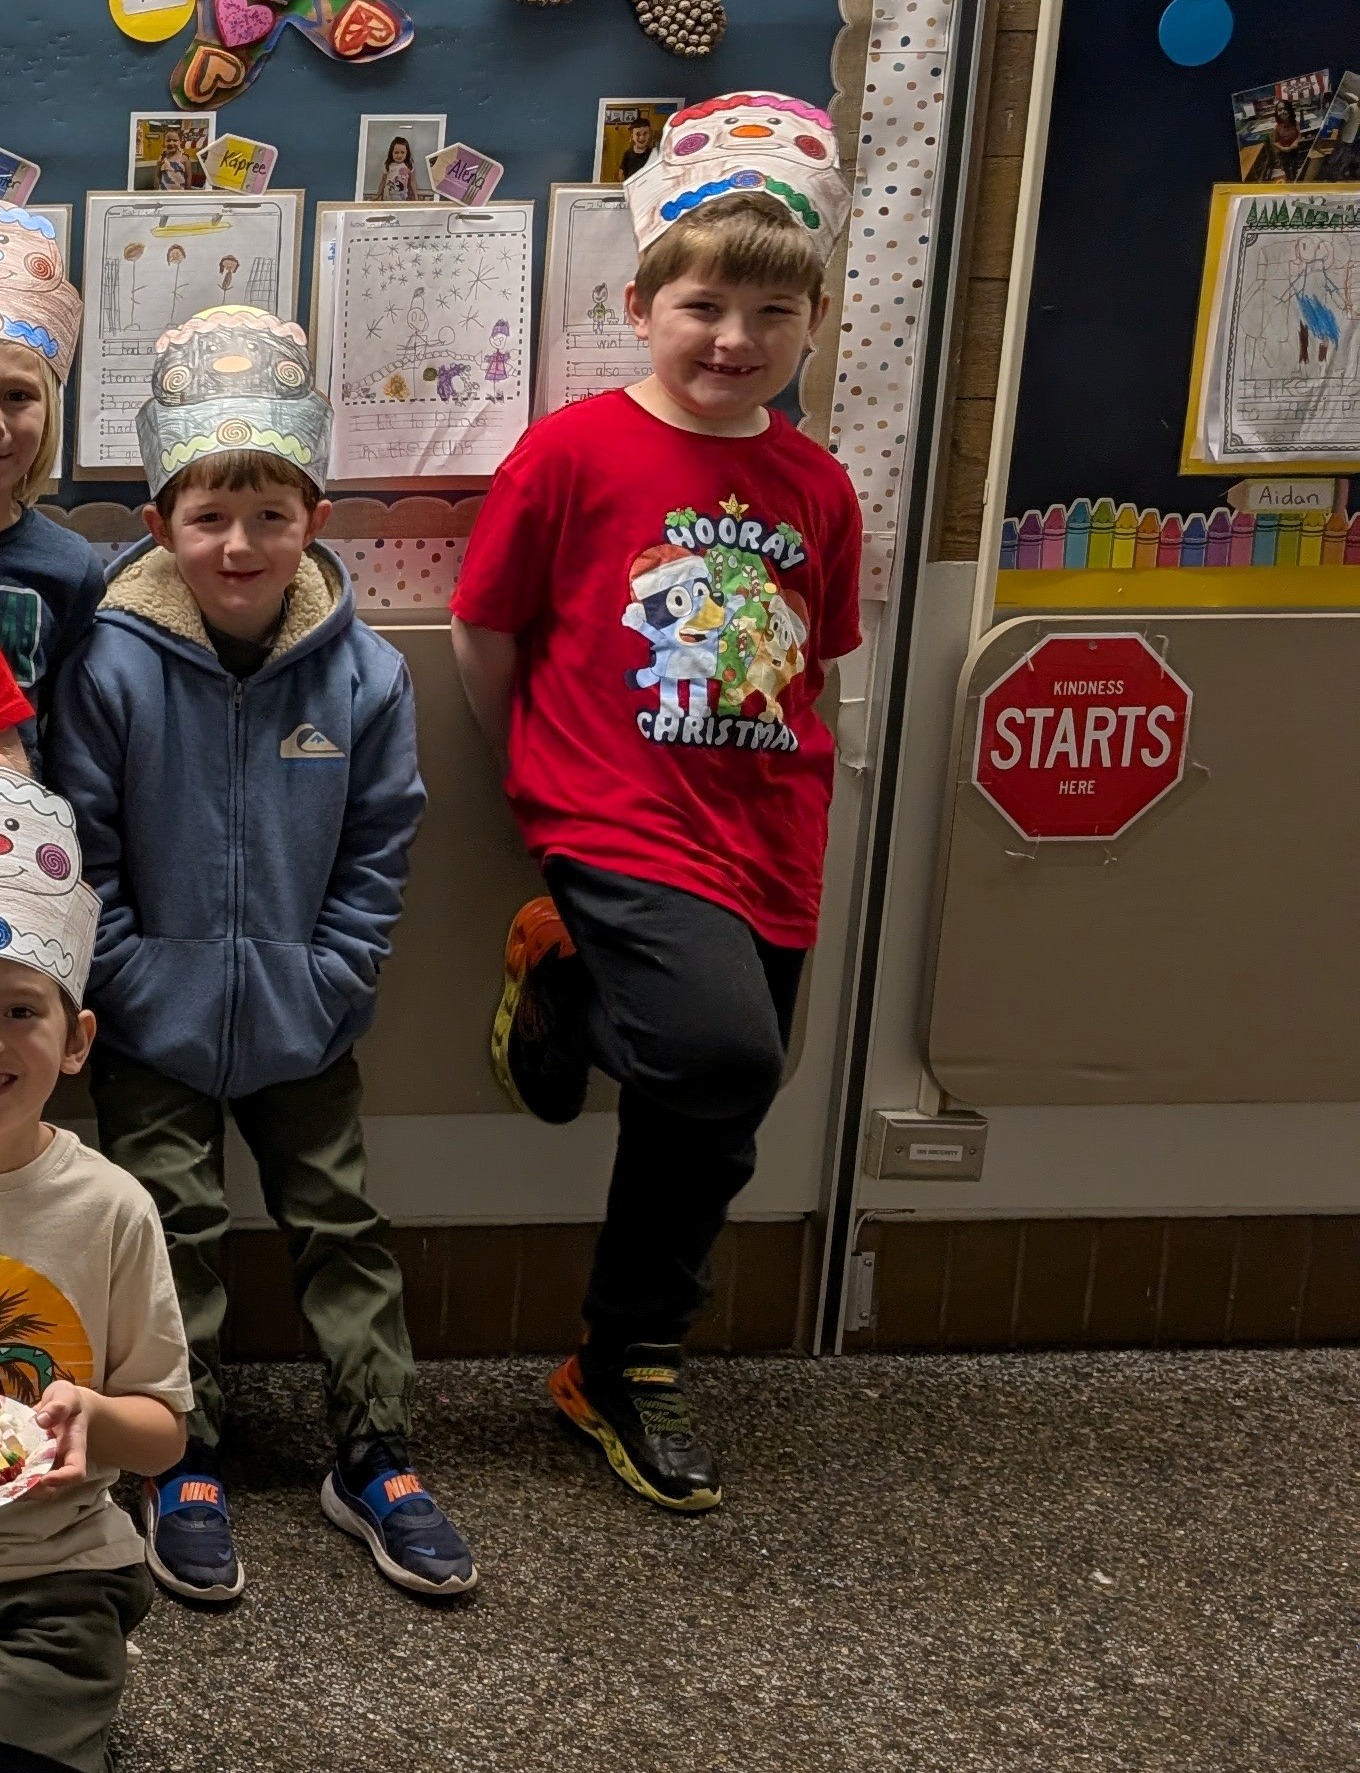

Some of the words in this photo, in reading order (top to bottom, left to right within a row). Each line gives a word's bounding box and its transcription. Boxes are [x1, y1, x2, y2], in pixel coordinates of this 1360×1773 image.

[220, 150, 267, 176] Kapree
[447, 159, 486, 190] Alena
[1258, 485, 1320, 506] Aidan
[666, 516, 805, 570] HOORAY
[1053, 680, 1125, 696] KINDNESS
[990, 705, 1175, 770] STARTS
[1058, 780, 1096, 795] HERE
[180, 1481, 219, 1504] NIKE
[383, 1473, 424, 1503] NIKE
